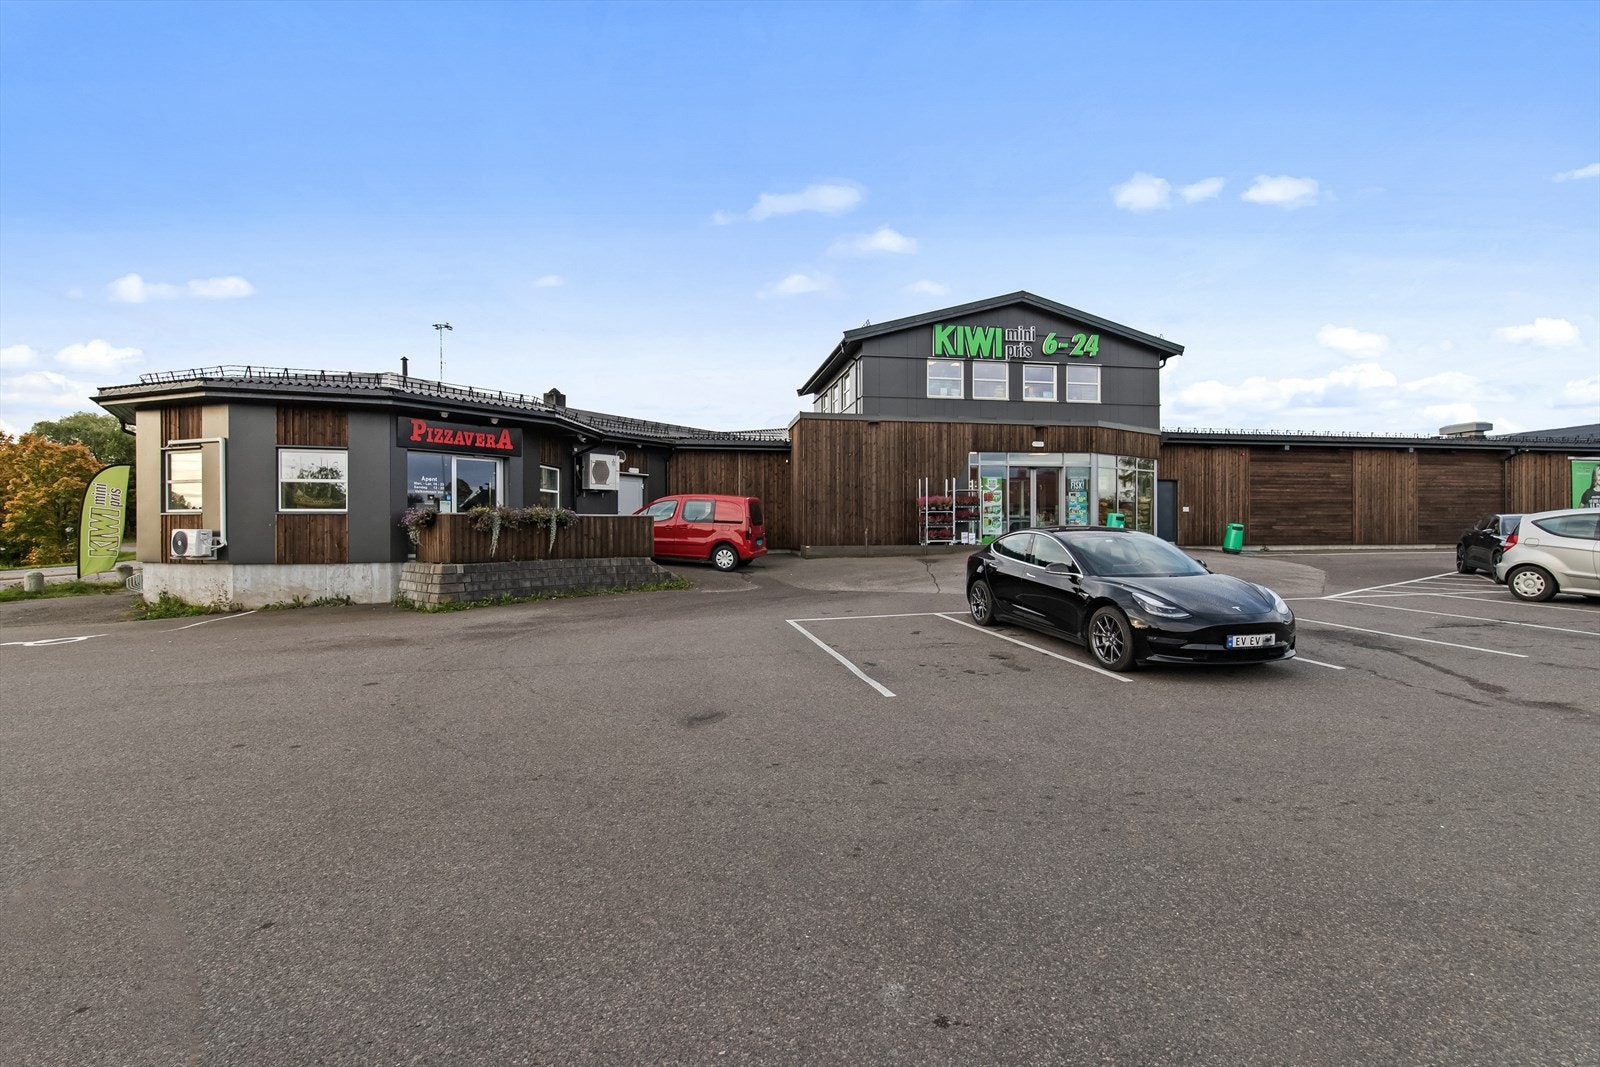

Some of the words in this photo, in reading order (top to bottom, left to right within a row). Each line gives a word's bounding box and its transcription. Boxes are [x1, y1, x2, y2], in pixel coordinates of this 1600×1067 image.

[932, 324, 1003, 358] KIWI
[1005, 325, 1036, 342] mini
[1005, 342, 1033, 360] pris
[410, 418, 513, 450] PIZZAVERA
[92, 483, 107, 505] mini
[107, 487, 124, 507] pris
[88, 506, 121, 557] KIWI
[1236, 637, 1247, 646] EV
[1249, 636, 1261, 646] EV
